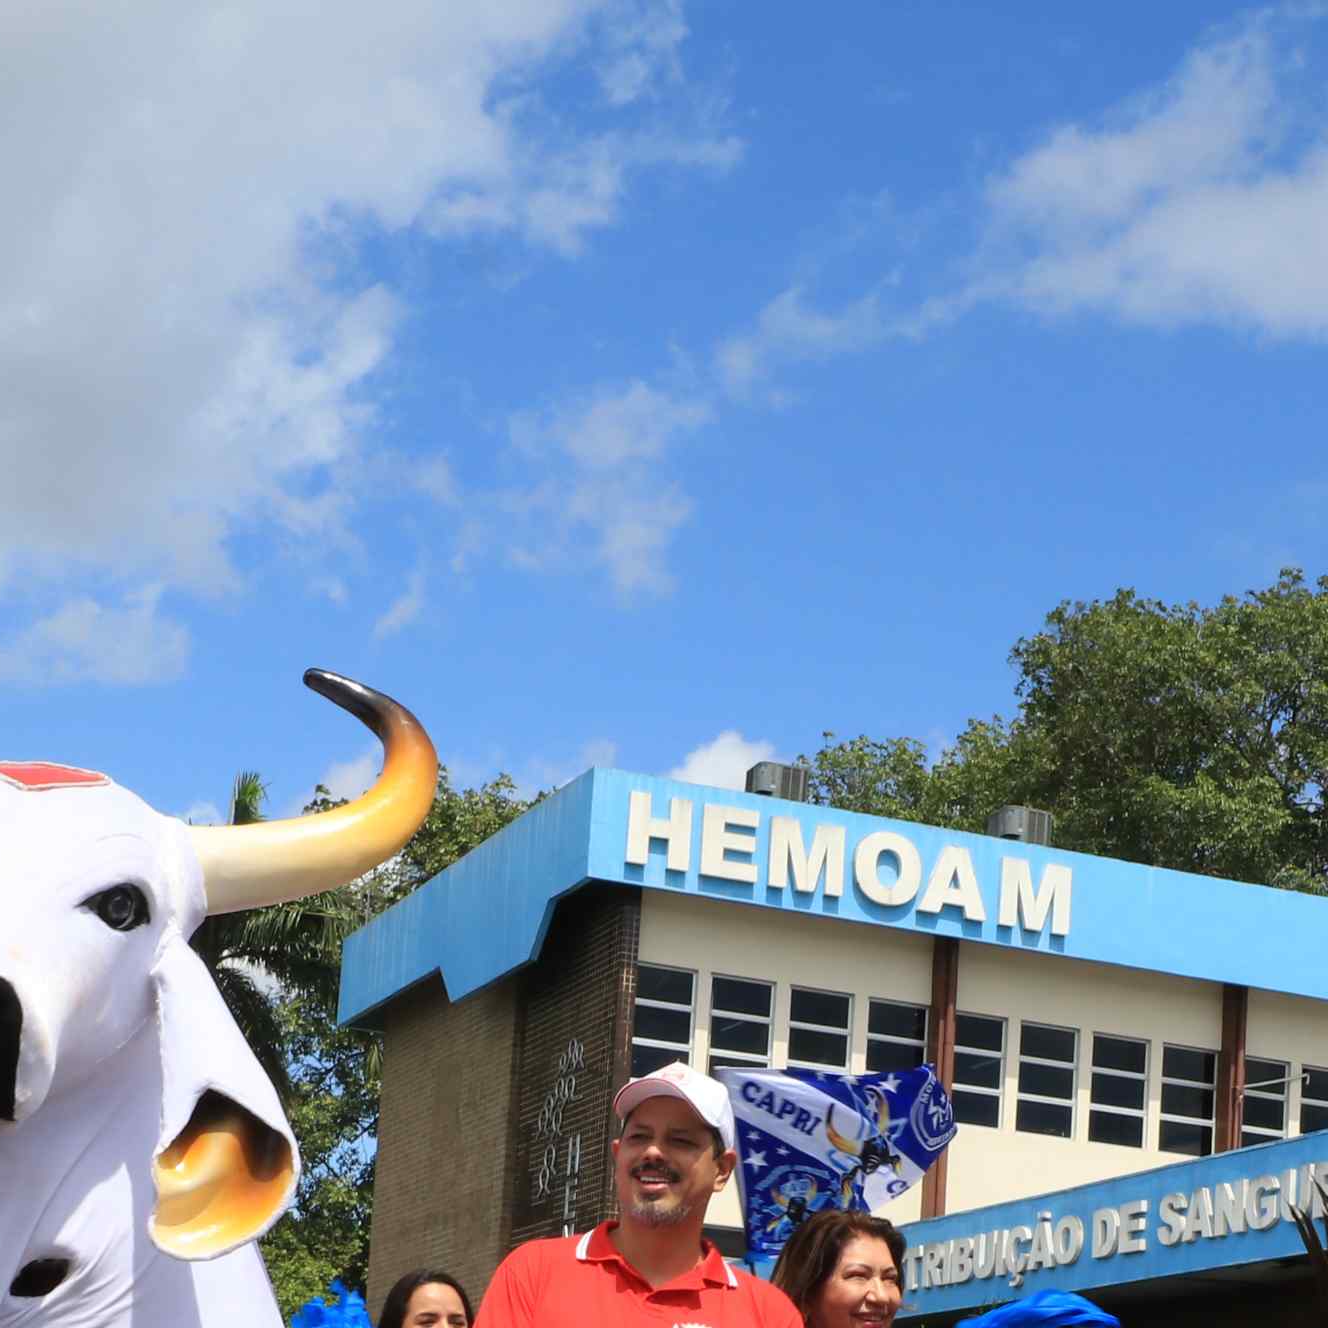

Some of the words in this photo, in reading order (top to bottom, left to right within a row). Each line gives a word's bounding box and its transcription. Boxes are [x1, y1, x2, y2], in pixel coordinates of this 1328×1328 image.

[625, 790, 1072, 936] HEMOAM
[741, 1081, 823, 1136] CAPRI
[1091, 1200, 1148, 1260] DE
